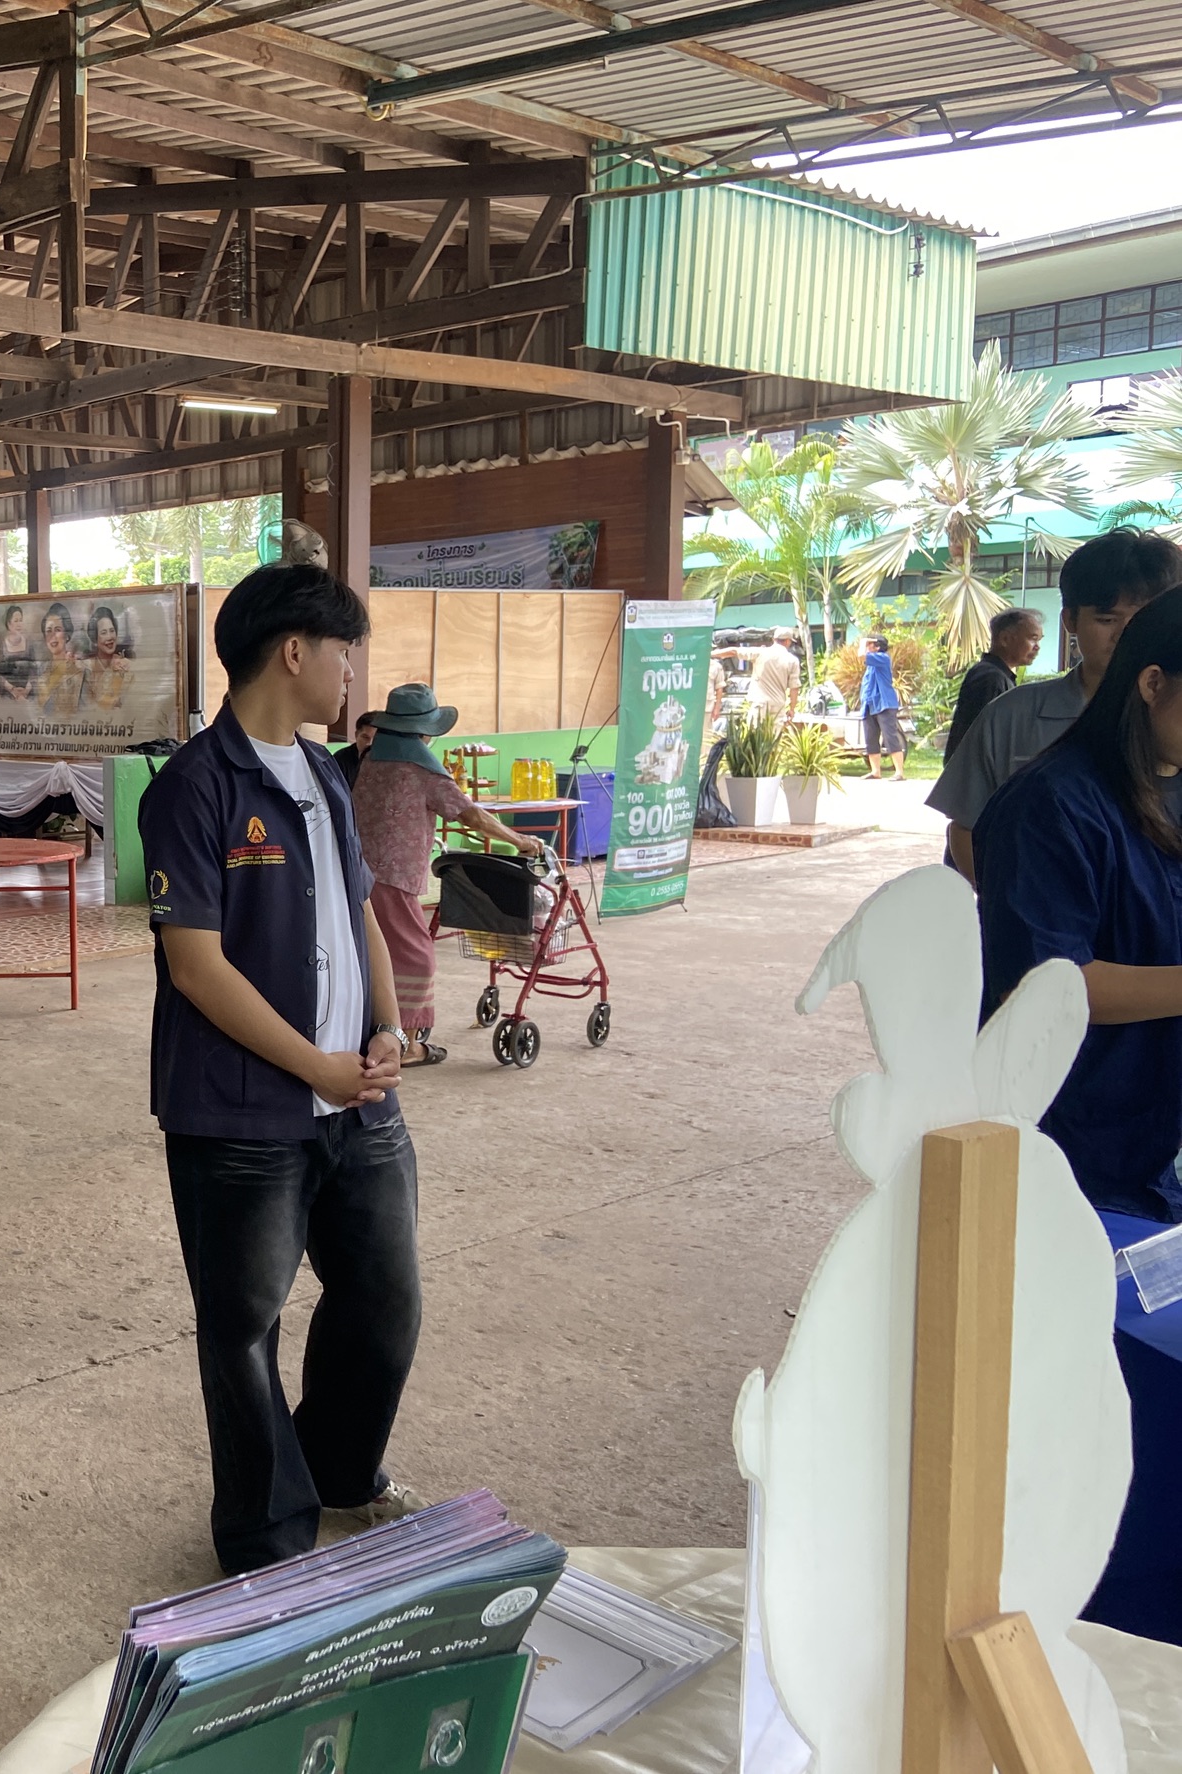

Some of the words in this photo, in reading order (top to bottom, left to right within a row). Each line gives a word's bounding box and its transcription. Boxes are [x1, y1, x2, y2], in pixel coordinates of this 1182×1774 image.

[426, 543, 475, 560] โครงการ
[642, 663, 693, 699] ถุงเงิน
[627, 791, 644, 804] 100
[628, 803, 673, 836] 900
